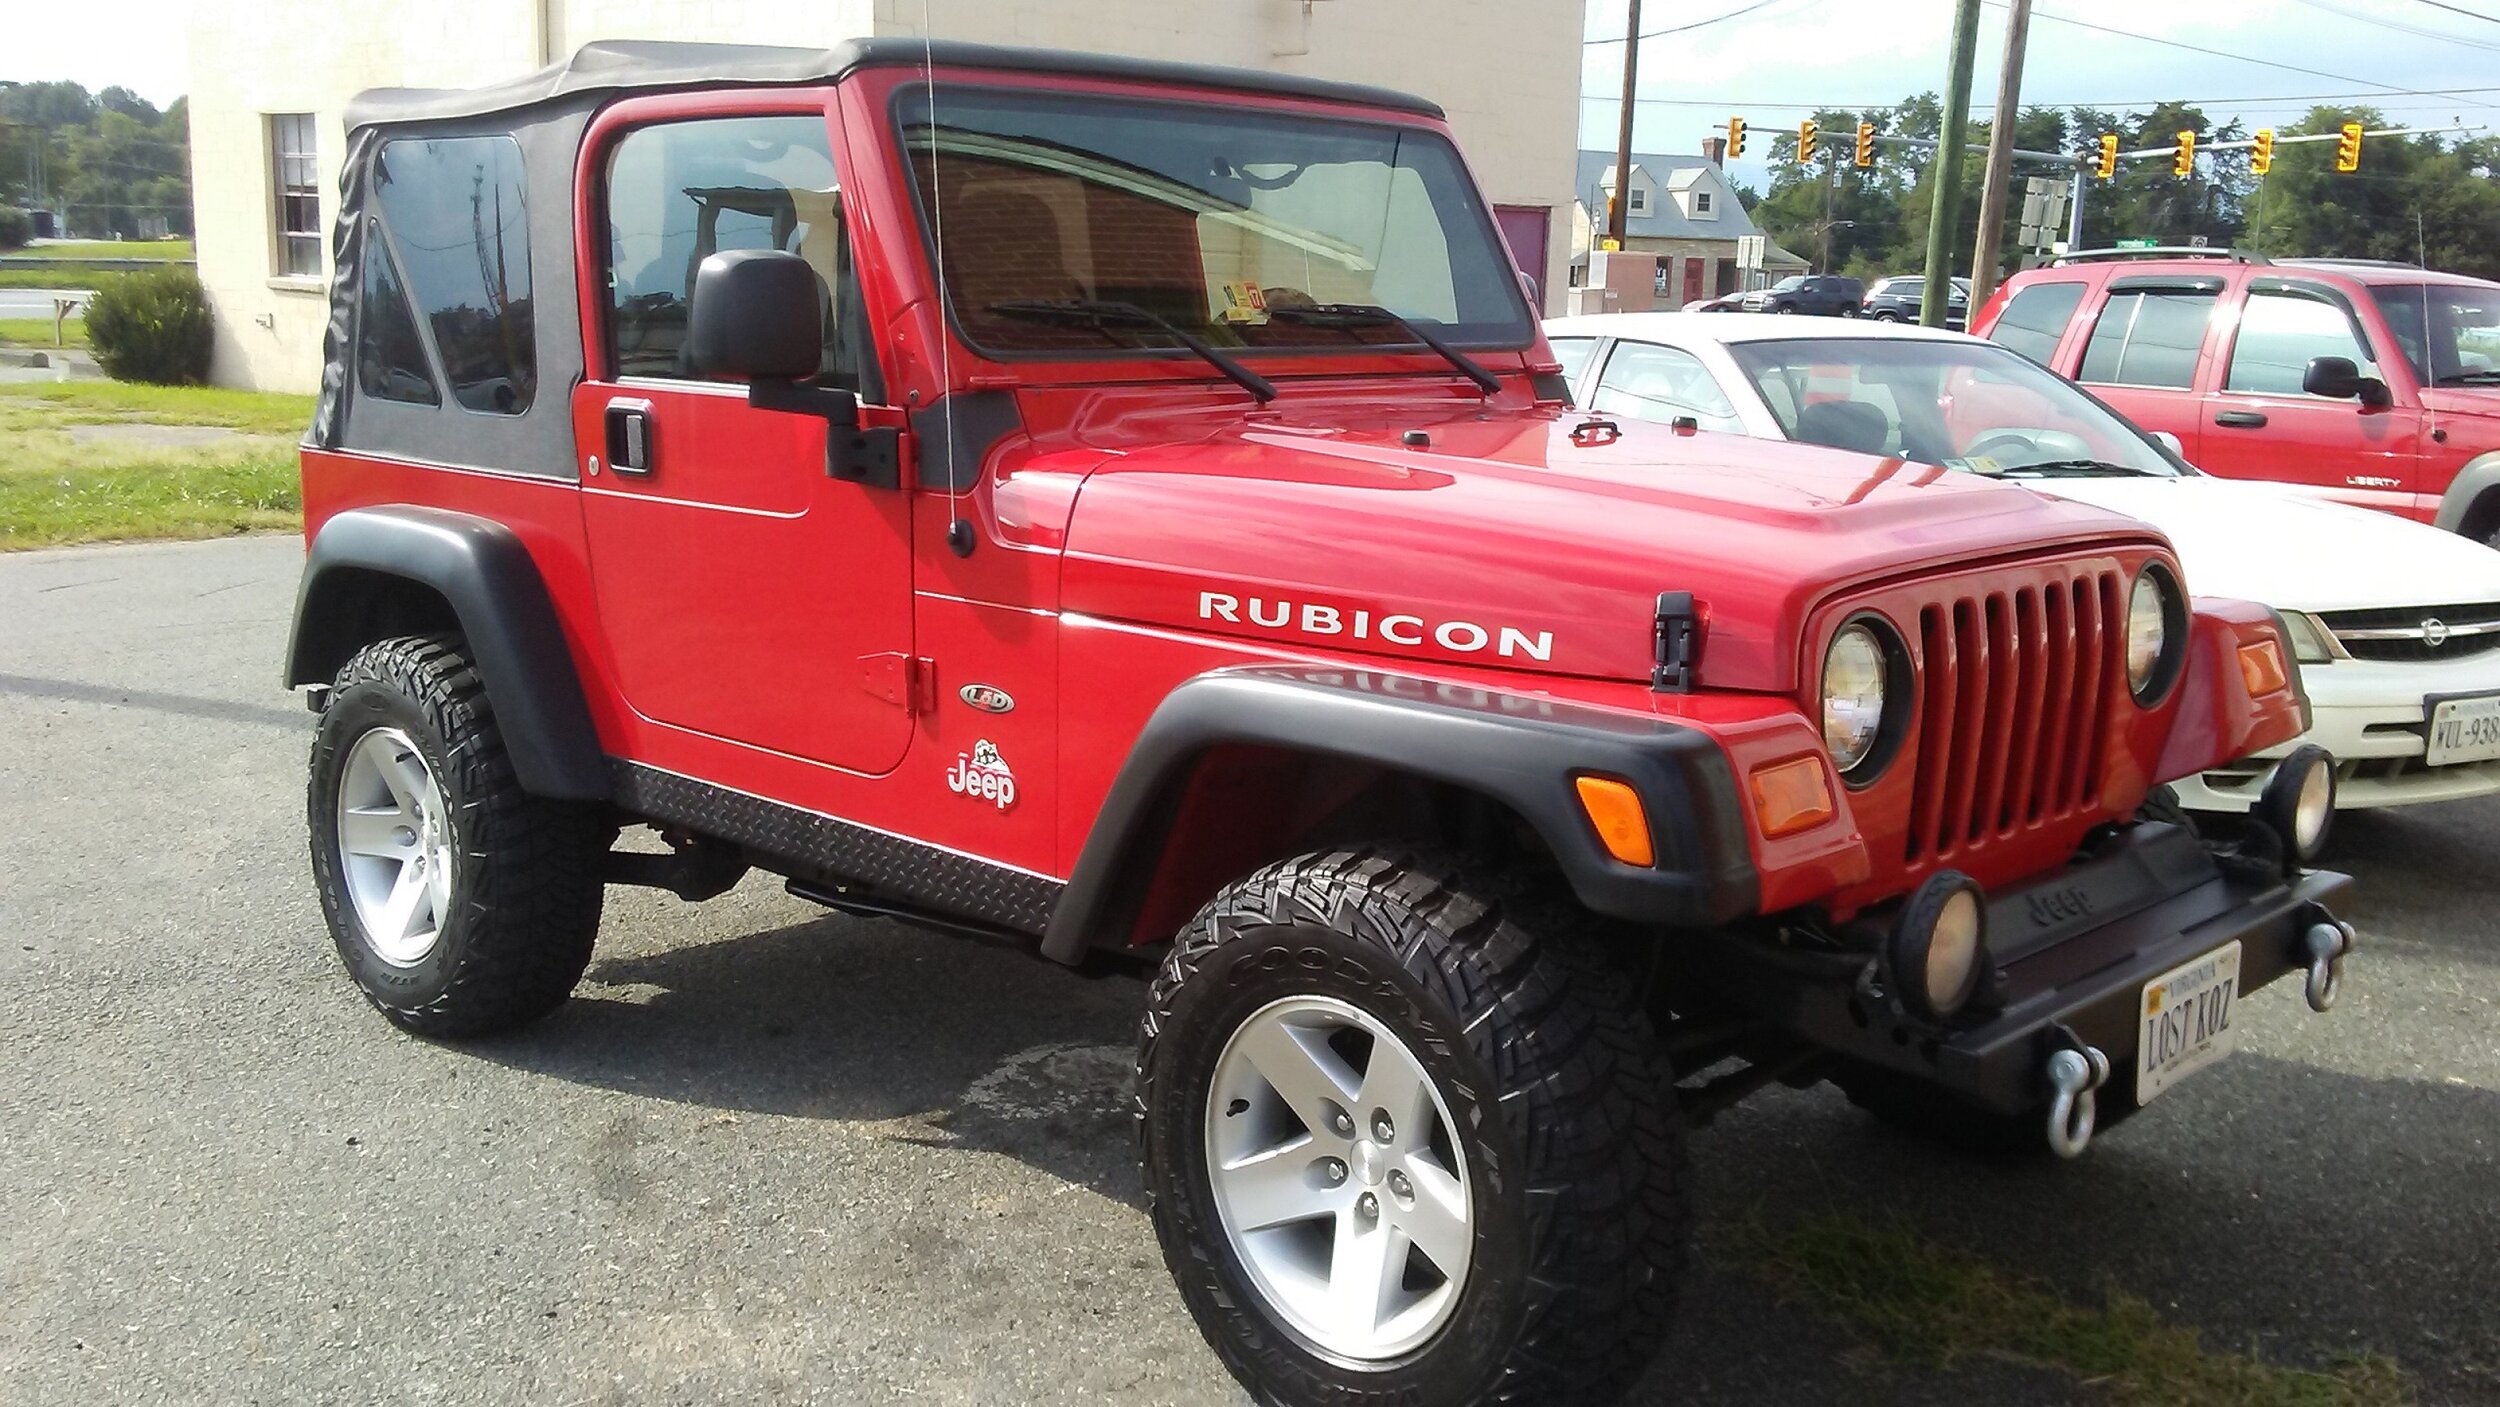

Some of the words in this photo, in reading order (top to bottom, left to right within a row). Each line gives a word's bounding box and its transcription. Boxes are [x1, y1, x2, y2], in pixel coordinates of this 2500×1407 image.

[2346, 475, 2401, 487] LIBERTY
[1200, 592, 1553, 661] RUBICON
[947, 752, 1015, 808] Jeep
[2026, 888, 2094, 927] Jeep
